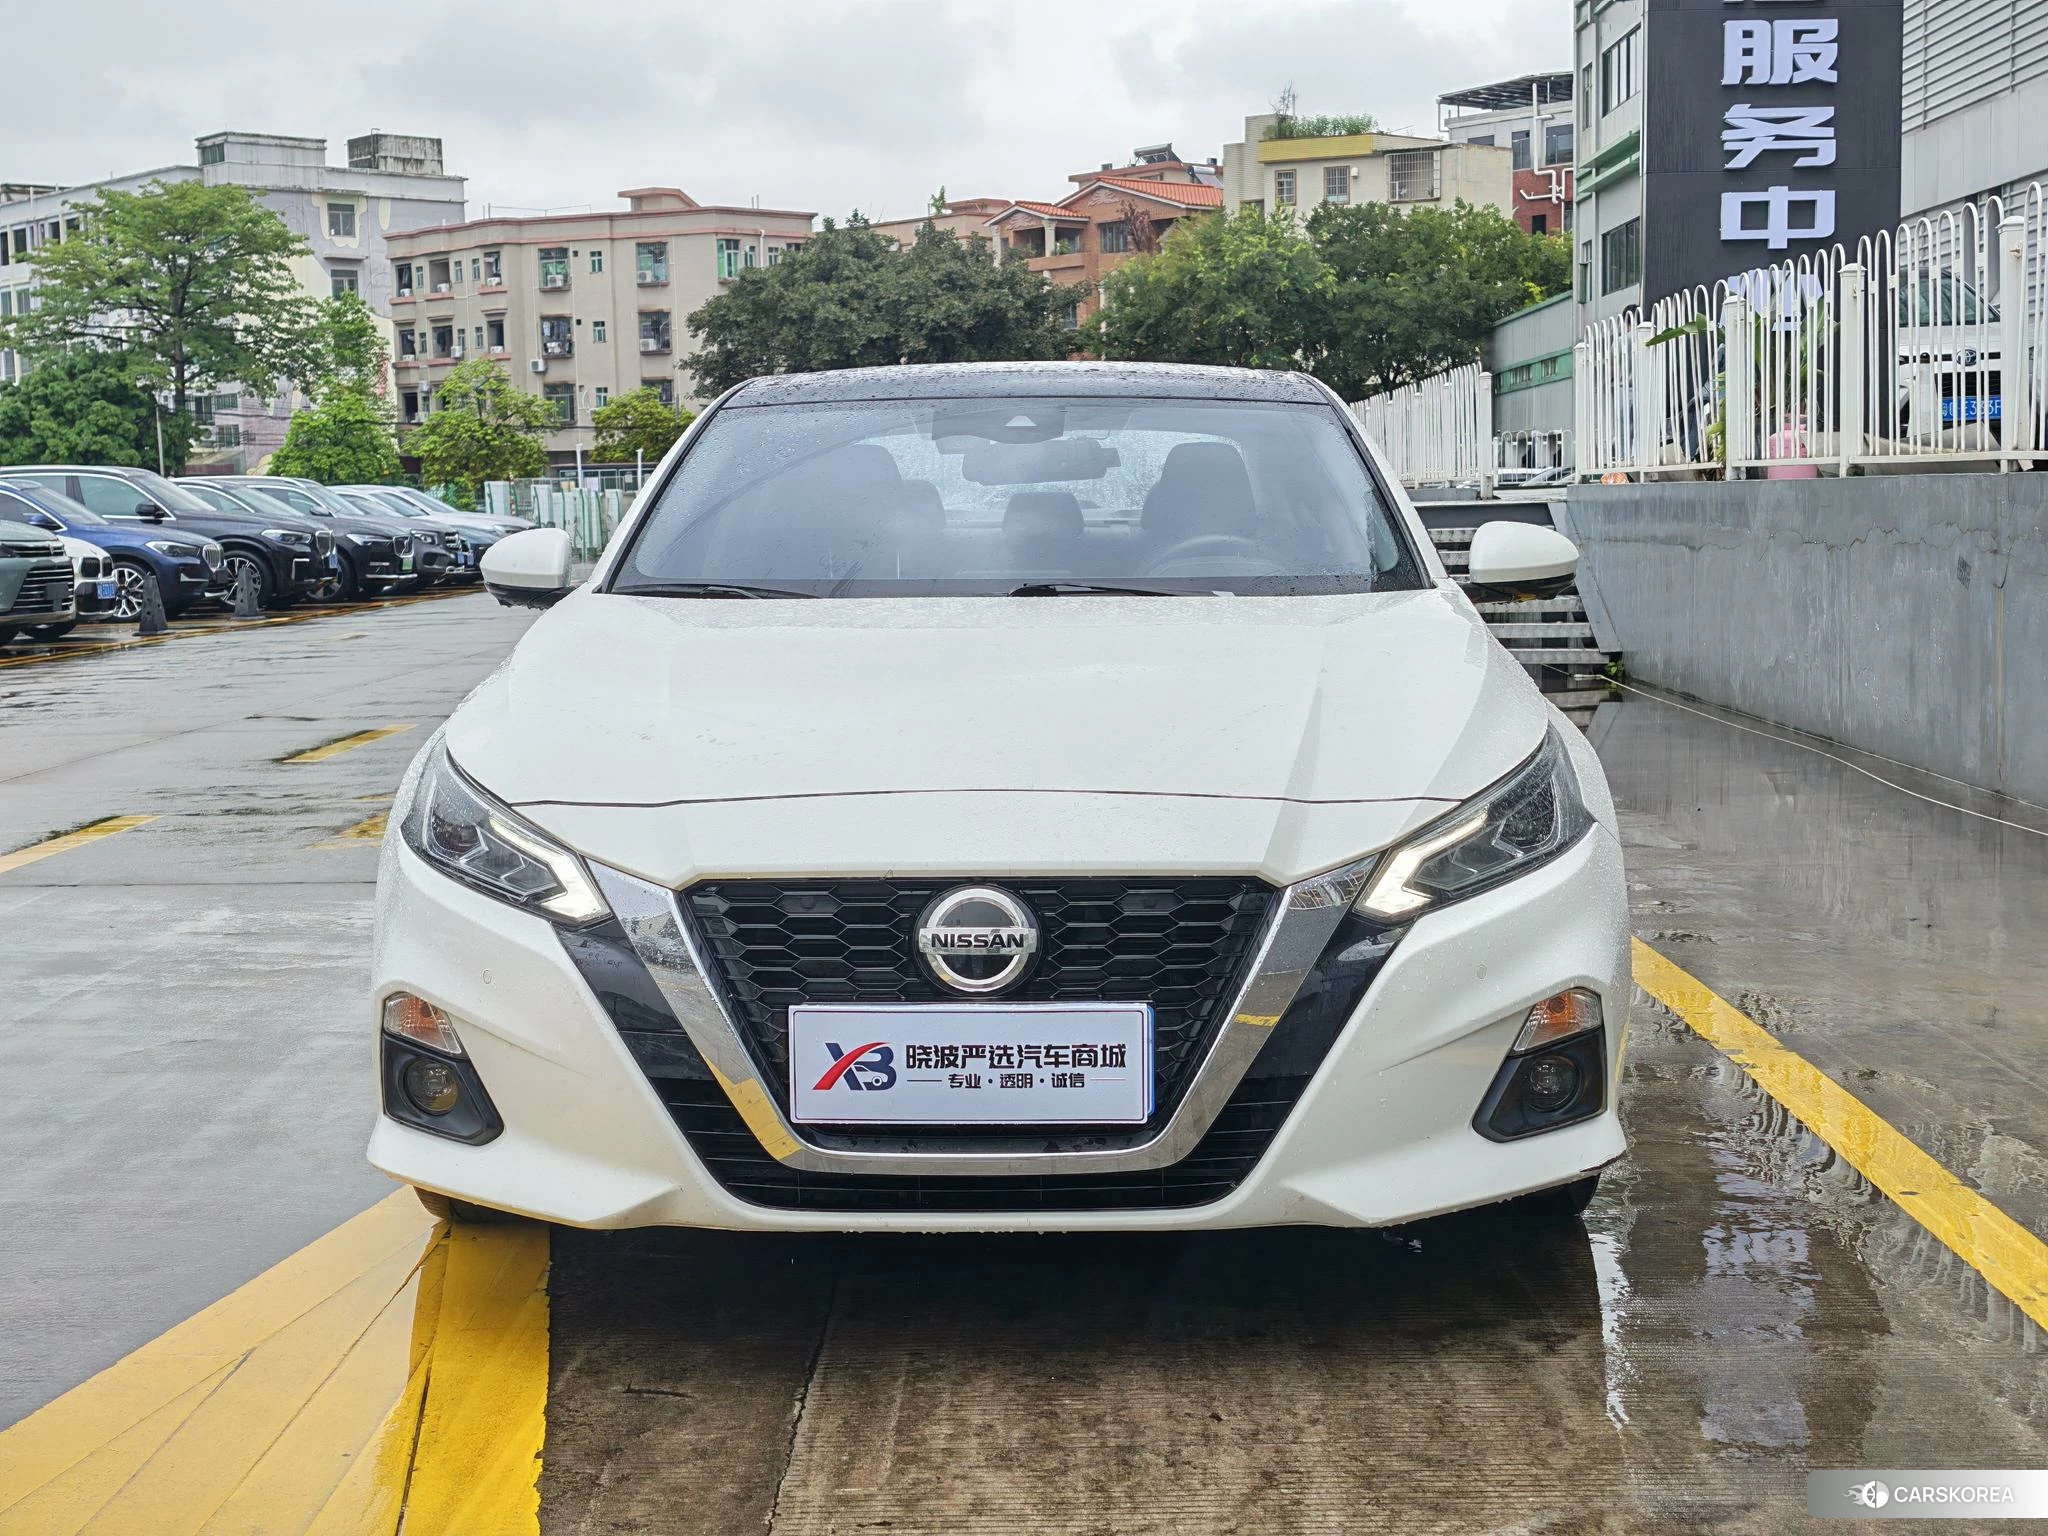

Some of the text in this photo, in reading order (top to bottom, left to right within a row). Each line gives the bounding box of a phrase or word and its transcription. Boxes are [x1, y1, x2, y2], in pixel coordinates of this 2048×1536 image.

[931, 933, 1024, 948] NISSAN
[905, 1043, 1127, 1069] 晓波严选汽车商城
